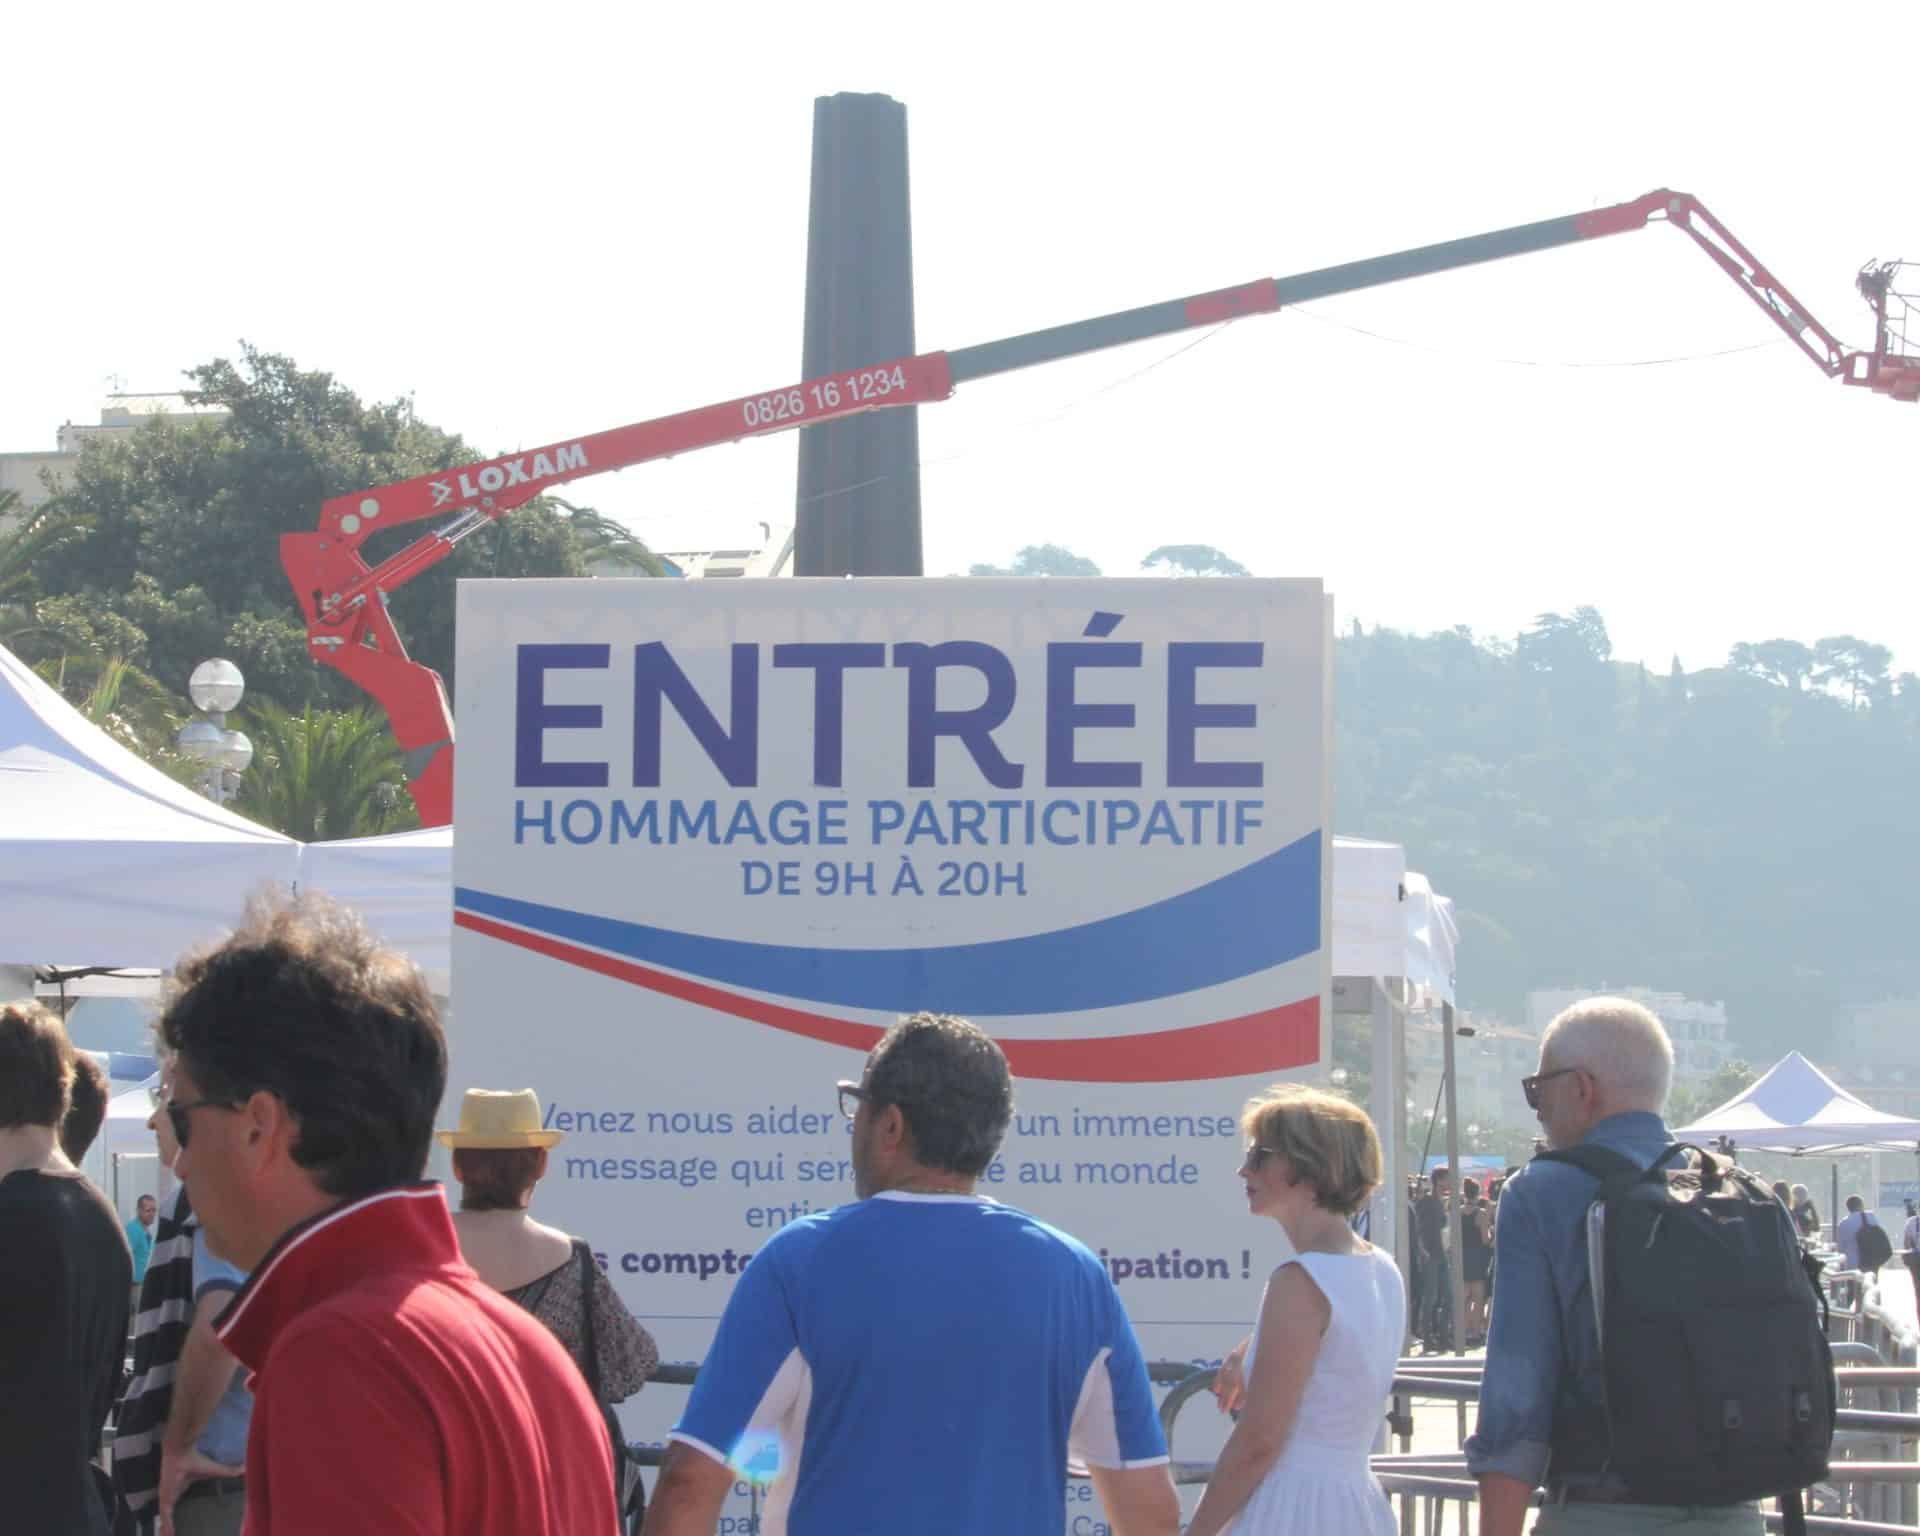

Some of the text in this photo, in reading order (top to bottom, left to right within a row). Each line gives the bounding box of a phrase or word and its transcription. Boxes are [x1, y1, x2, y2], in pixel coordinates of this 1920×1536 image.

[743, 365, 906, 426] 0826 16 1234
[458, 444, 589, 498] LOXAM
[514, 611, 1264, 790] ENTRÉE
[514, 799, 1264, 846] HOMMAGE PARTICIPATIF
[740, 855, 1027, 897] DE 9H À 20H
[647, 1112, 733, 1134] nous
[746, 1104, 834, 1135] aider
[1016, 1112, 1061, 1137] un
[1073, 1107, 1235, 1138] immense
[565, 1157, 717, 1188] message
[730, 1152, 785, 1188] qui
[797, 1160, 856, 1182] ser
[1018, 1162, 1062, 1185] au
[1074, 1154, 1199, 1185] monde
